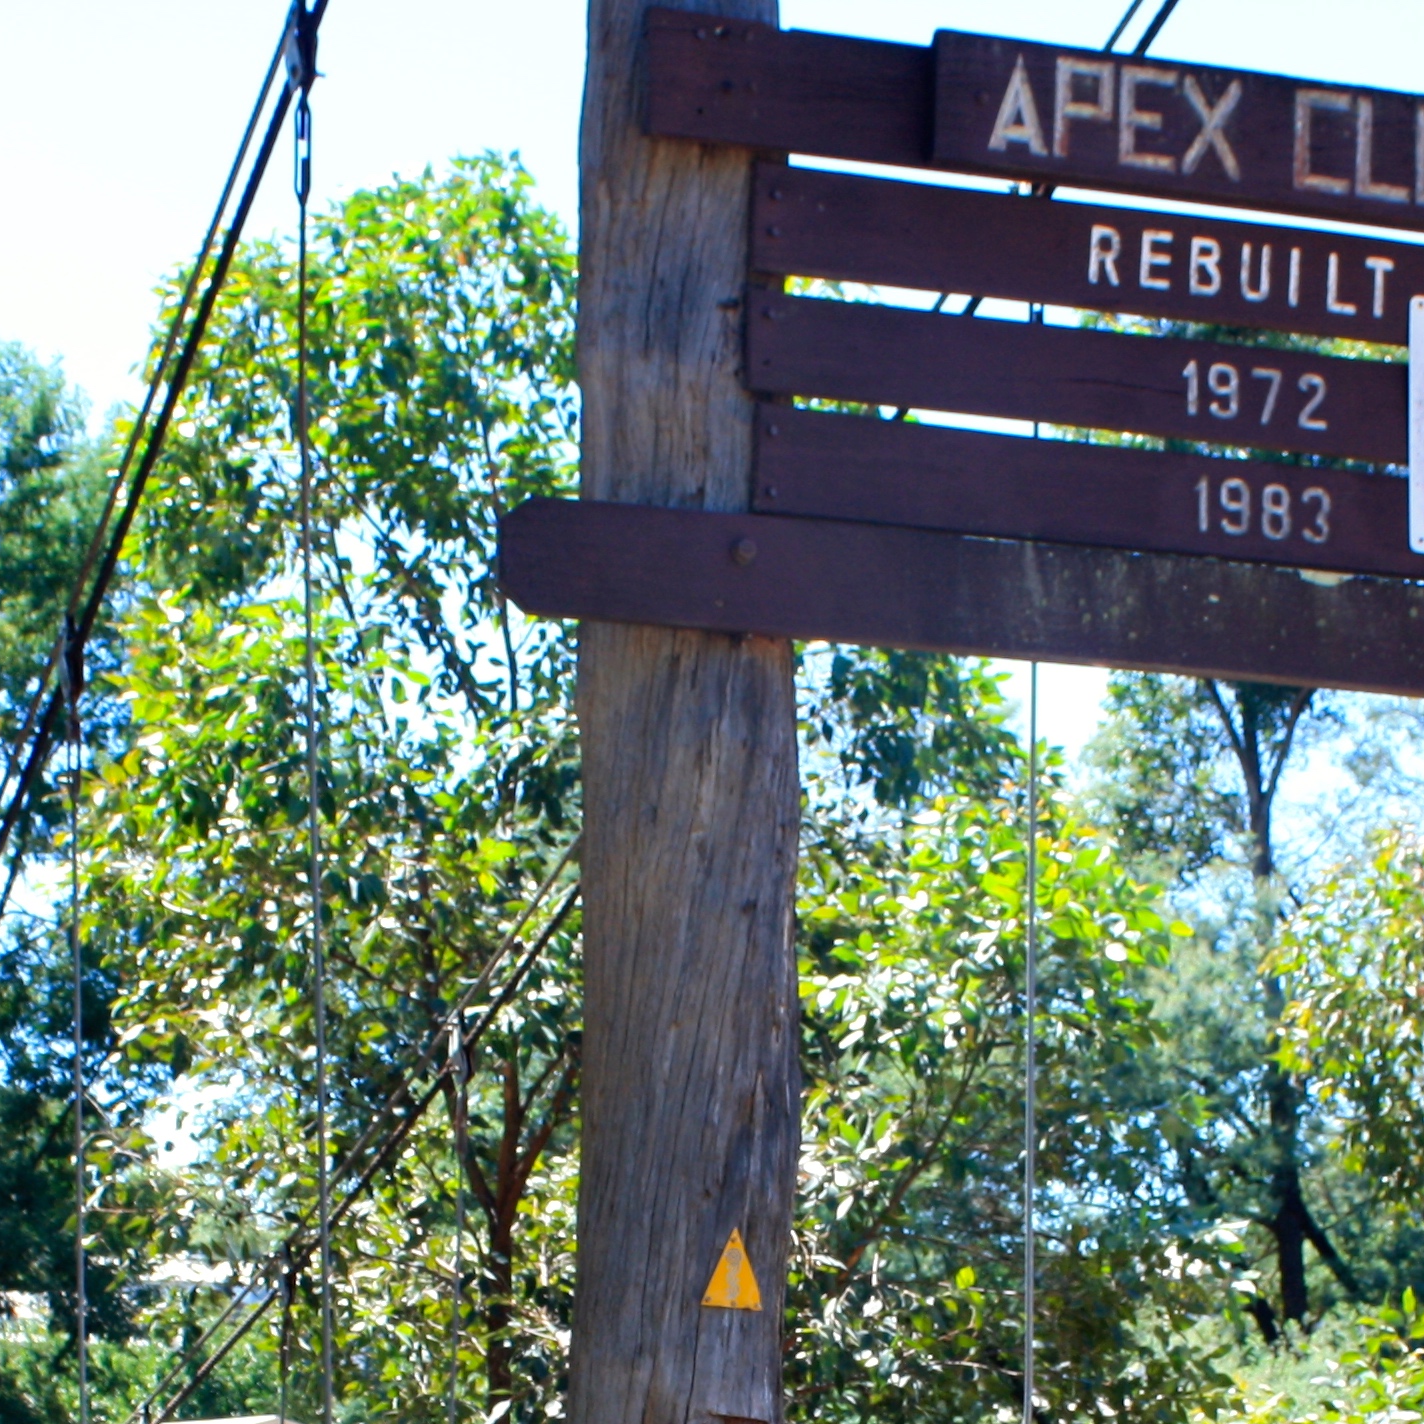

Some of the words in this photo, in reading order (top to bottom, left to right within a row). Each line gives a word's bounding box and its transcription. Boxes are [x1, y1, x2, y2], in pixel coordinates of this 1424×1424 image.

[987, 54, 1241, 182] APEX
[1087, 223, 1395, 318] REBUILT
[1181, 358, 1330, 431] 1972
[1193, 474, 1332, 544] 1983
